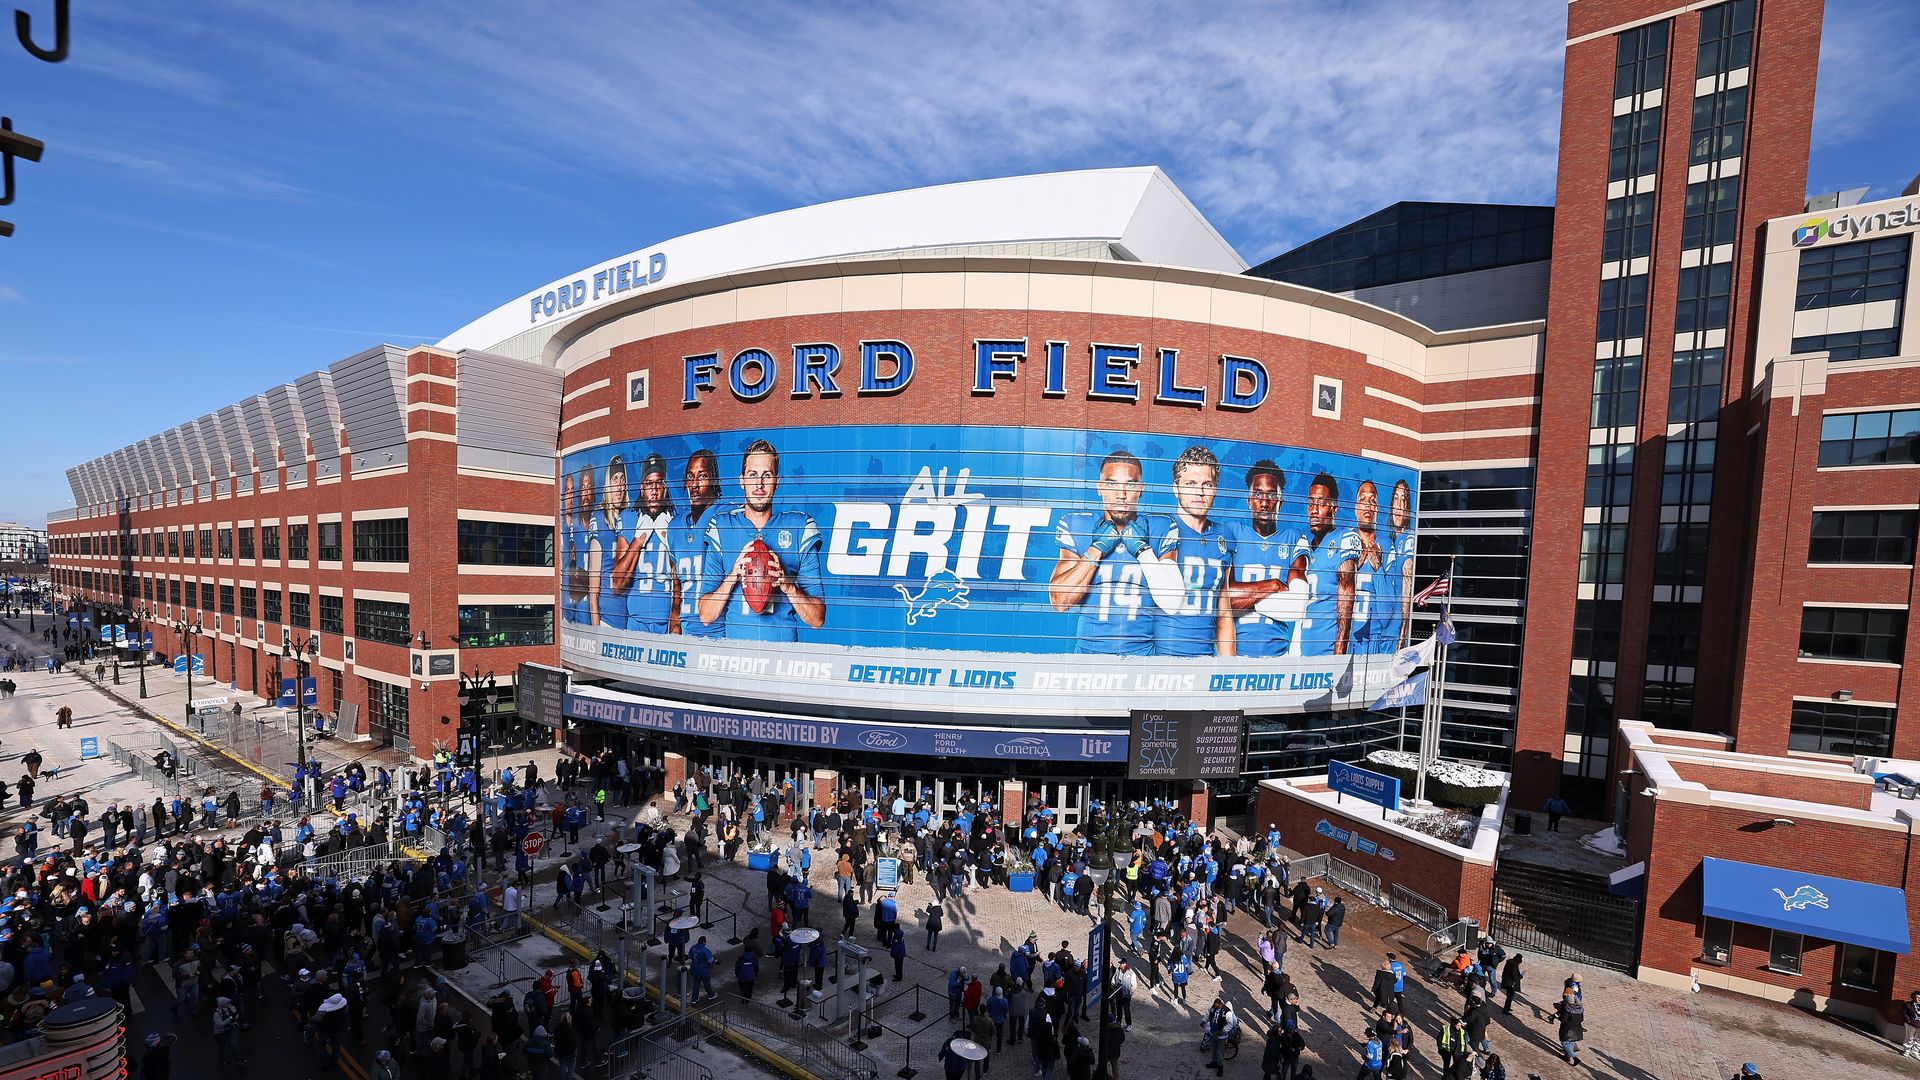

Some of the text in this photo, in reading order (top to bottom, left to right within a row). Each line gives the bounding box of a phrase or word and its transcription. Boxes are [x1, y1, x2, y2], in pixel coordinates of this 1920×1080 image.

[530, 252, 668, 323] FORD FIELD
[682, 337, 1270, 411] FORD FIELD
[900, 465, 986, 509] ALL
[827, 502, 1053, 580] GRIT
[679, 554, 703, 615] 21
[1097, 563, 1144, 622] 14
[1178, 556, 1223, 616] 87
[601, 641, 687, 668] DETROIT LIONS
[698, 653, 833, 680] DETROIT LIONS
[848, 664, 1017, 690] DETROIT LIONS
[1032, 672, 1196, 692] DETROIT LIONS
[1209, 672, 1334, 692] DETROIT LIONS
[573, 699, 839, 745] DETROIT LIONS PLAYOFFS PRESENTED BY
[1149, 714, 1163, 722] you
[1213, 715, 1239, 723] REPORT
[866, 730, 899, 748] Ford
[934, 732, 963, 740] HENRY
[1141, 721, 1179, 741] SEE
[1203, 725, 1238, 733] ANYTHING
[460, 739, 471, 755] A
[1080, 738, 1113, 758] Lite
[1196, 746, 1237, 754] TO STADIUM
[1139, 747, 1179, 768] SAY
[1210, 766, 1235, 774] POLICE
[1350, 772, 1365, 785] LIONS
[1365, 776, 1385, 791] SUPPLY
[524, 838, 543, 850] STOP
[1336, 832, 1350, 842] GATE
[1346, 831, 1359, 852] A
[1091, 932, 1101, 983] LIONS
[1173, 963, 1185, 974] 20
